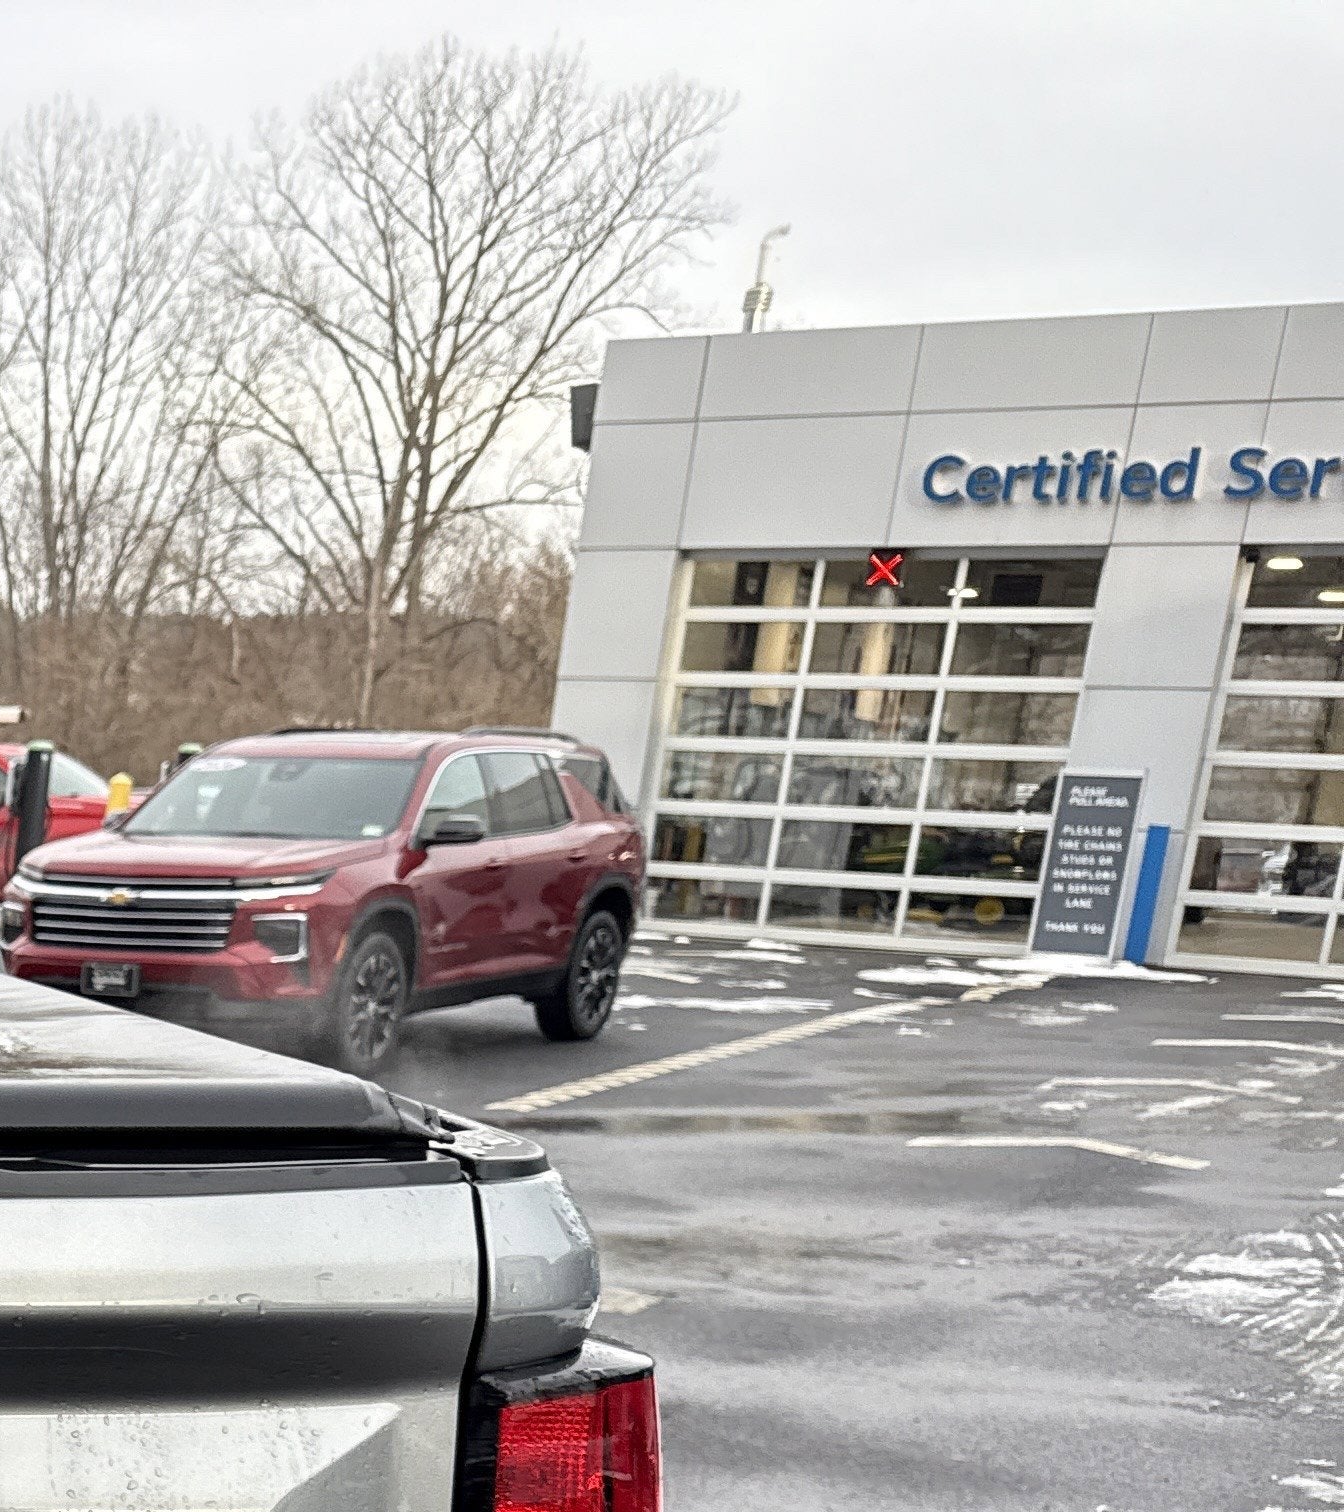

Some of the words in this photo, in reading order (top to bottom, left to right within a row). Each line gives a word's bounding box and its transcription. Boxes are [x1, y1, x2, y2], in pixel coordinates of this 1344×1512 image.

[921, 446, 1202, 503] Certified
[1062, 824, 1104, 837] PLEASE
[1107, 825, 1123, 838] NO
[1058, 839, 1081, 851] TIRE
[1084, 841, 1123, 853] CHAINS
[1060, 853, 1095, 866] STUDS
[1098, 855, 1114, 867] OR
[1053, 883, 1065, 894] IN
[1067, 883, 1111, 896] SERVICE
[1065, 897, 1093, 909] LANE
[1044, 920, 1079, 933] THANK
[1083, 922, 1106, 935] YOU
